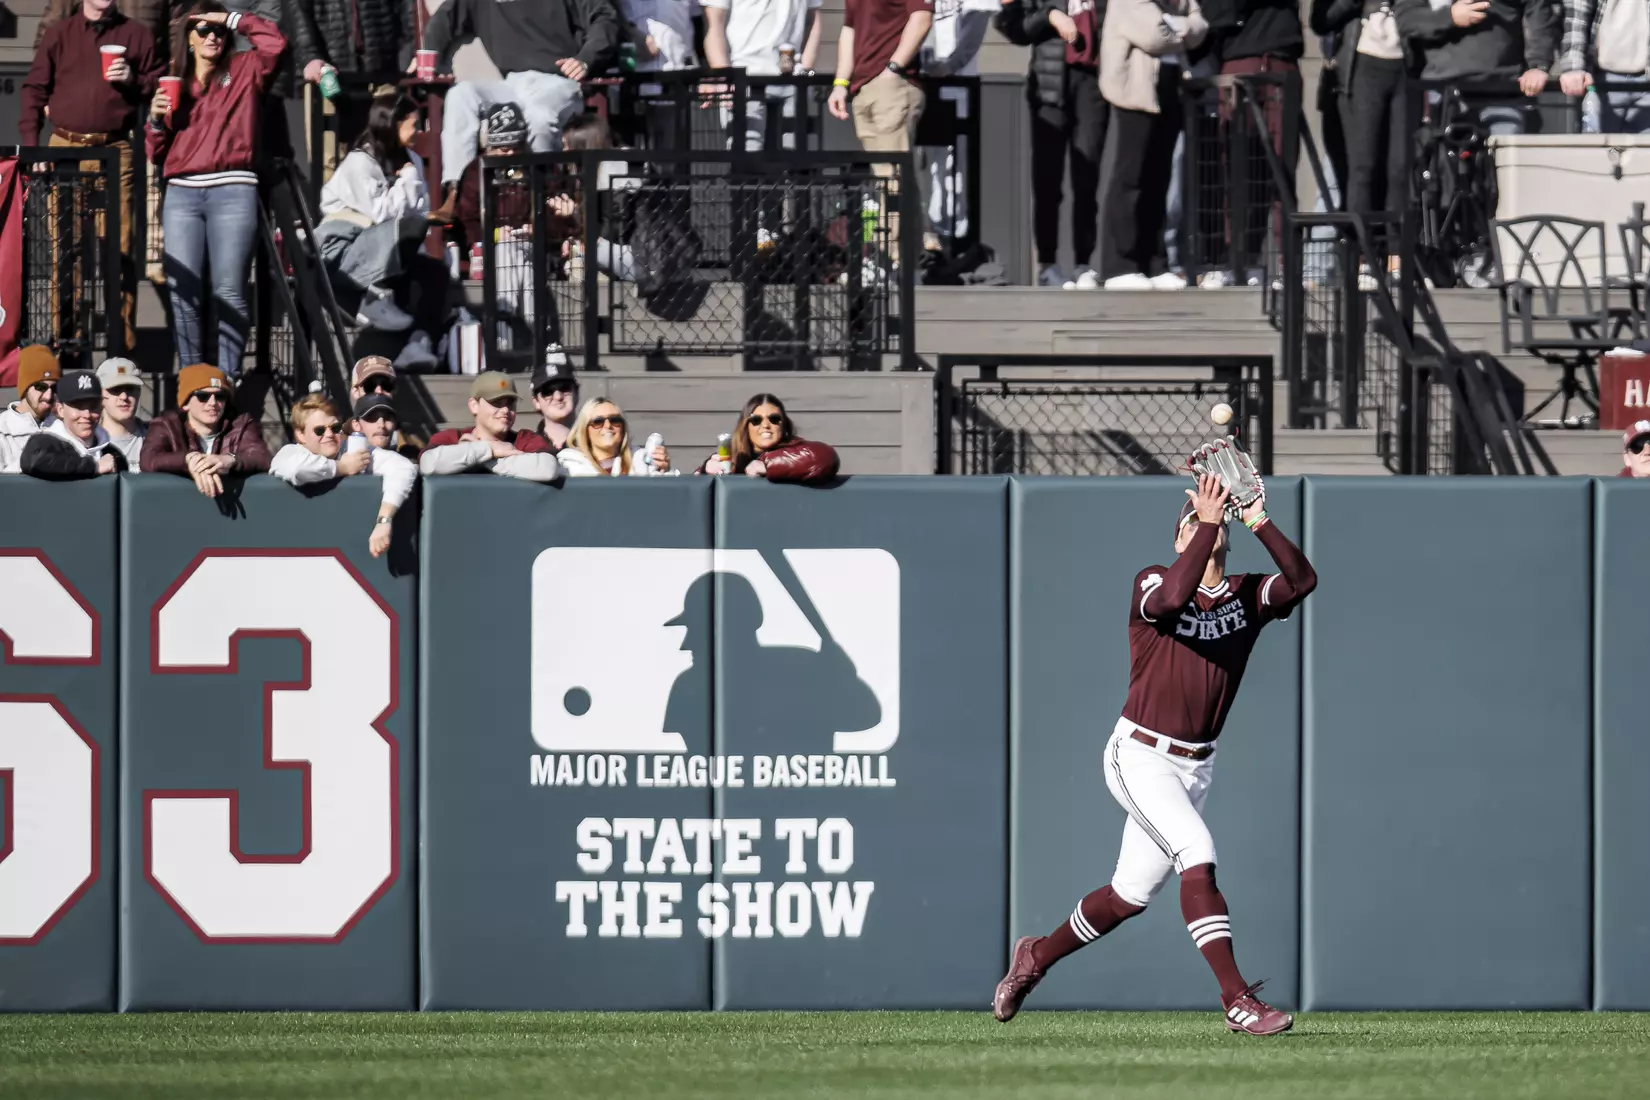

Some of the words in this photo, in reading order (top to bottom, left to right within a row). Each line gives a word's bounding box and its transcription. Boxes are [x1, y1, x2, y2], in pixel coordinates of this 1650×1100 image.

[1624, 379, 1650, 407] H
[530, 754, 628, 787] MAJOR
[637, 755, 745, 788] LEAGUE
[753, 755, 896, 788] BASEBALL
[576, 817, 762, 875] STATE
[775, 817, 855, 875] TO
[555, 881, 683, 938] THE
[697, 881, 875, 939] SHOW
